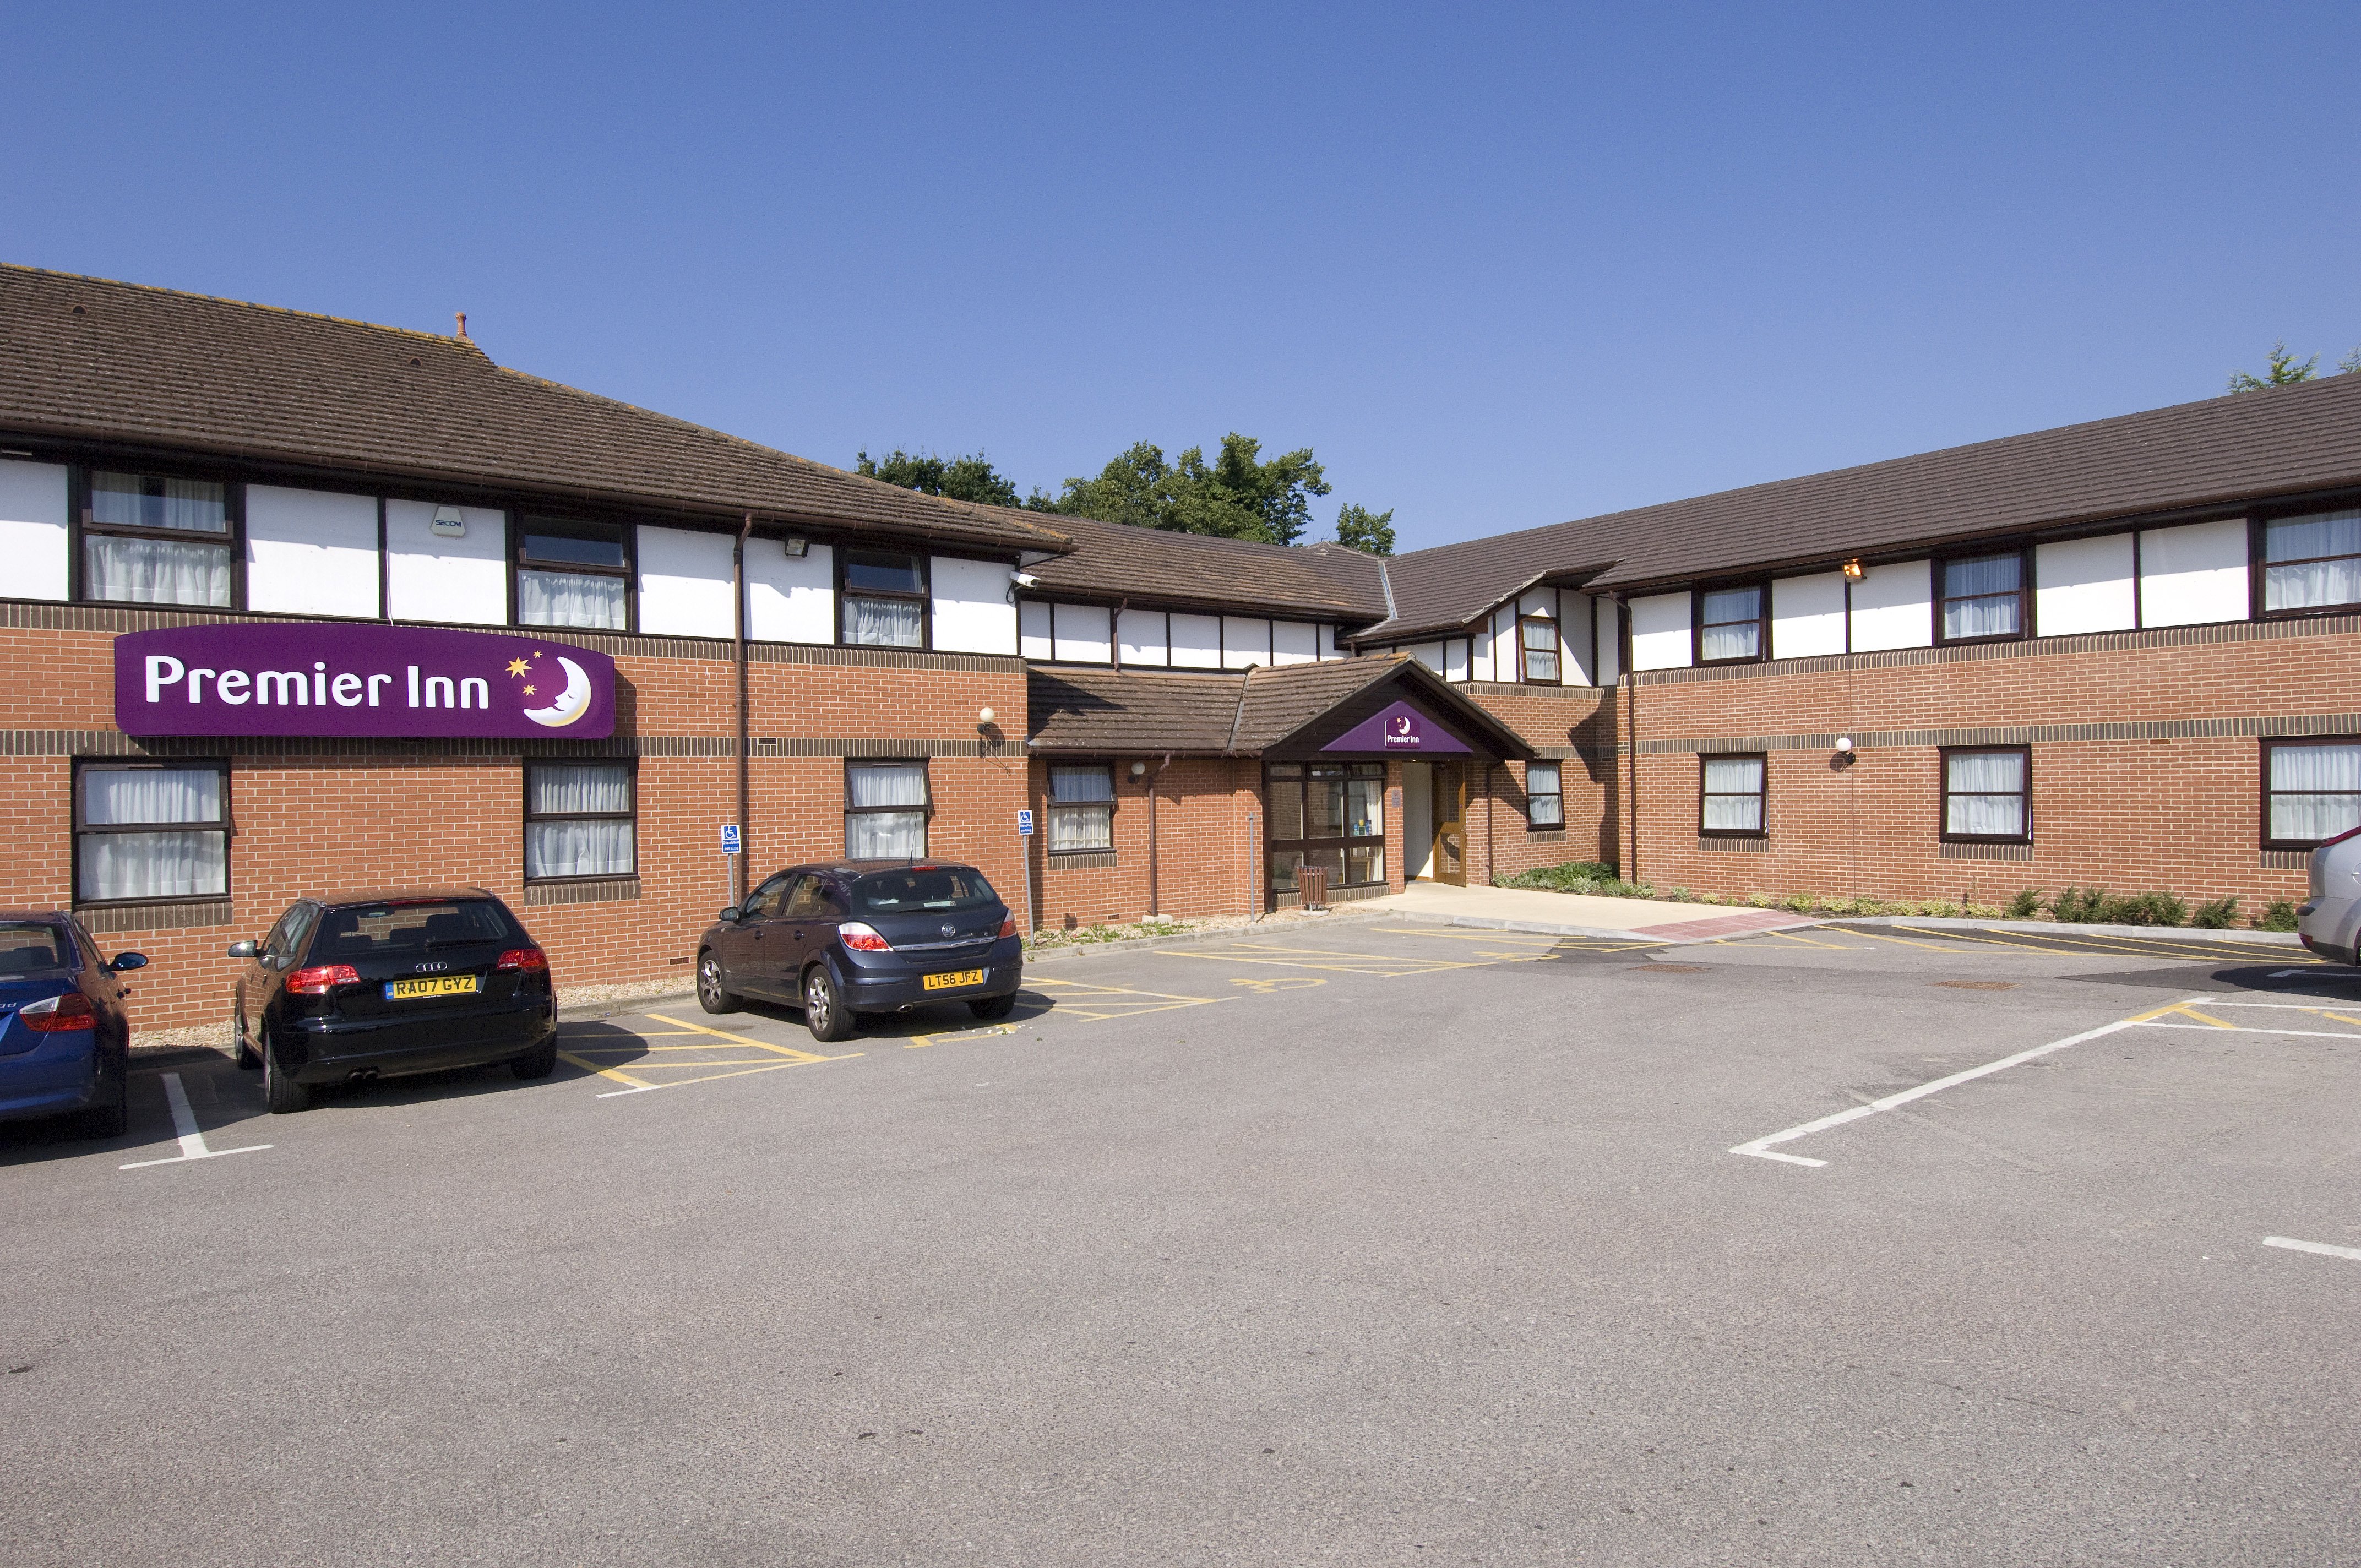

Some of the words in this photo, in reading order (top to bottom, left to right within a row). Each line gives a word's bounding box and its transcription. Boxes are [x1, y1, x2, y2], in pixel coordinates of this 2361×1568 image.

[436, 519, 462, 527] SECOM
[145, 655, 393, 707] Premier
[407, 665, 489, 709] Inn
[1387, 734, 1410, 743] Premier
[1410, 735, 1419, 743] Inn
[396, 979, 438, 995] RA07
[443, 976, 473, 991] GYZ
[928, 973, 956, 987] LT56
[959, 971, 978, 983] JFZ
